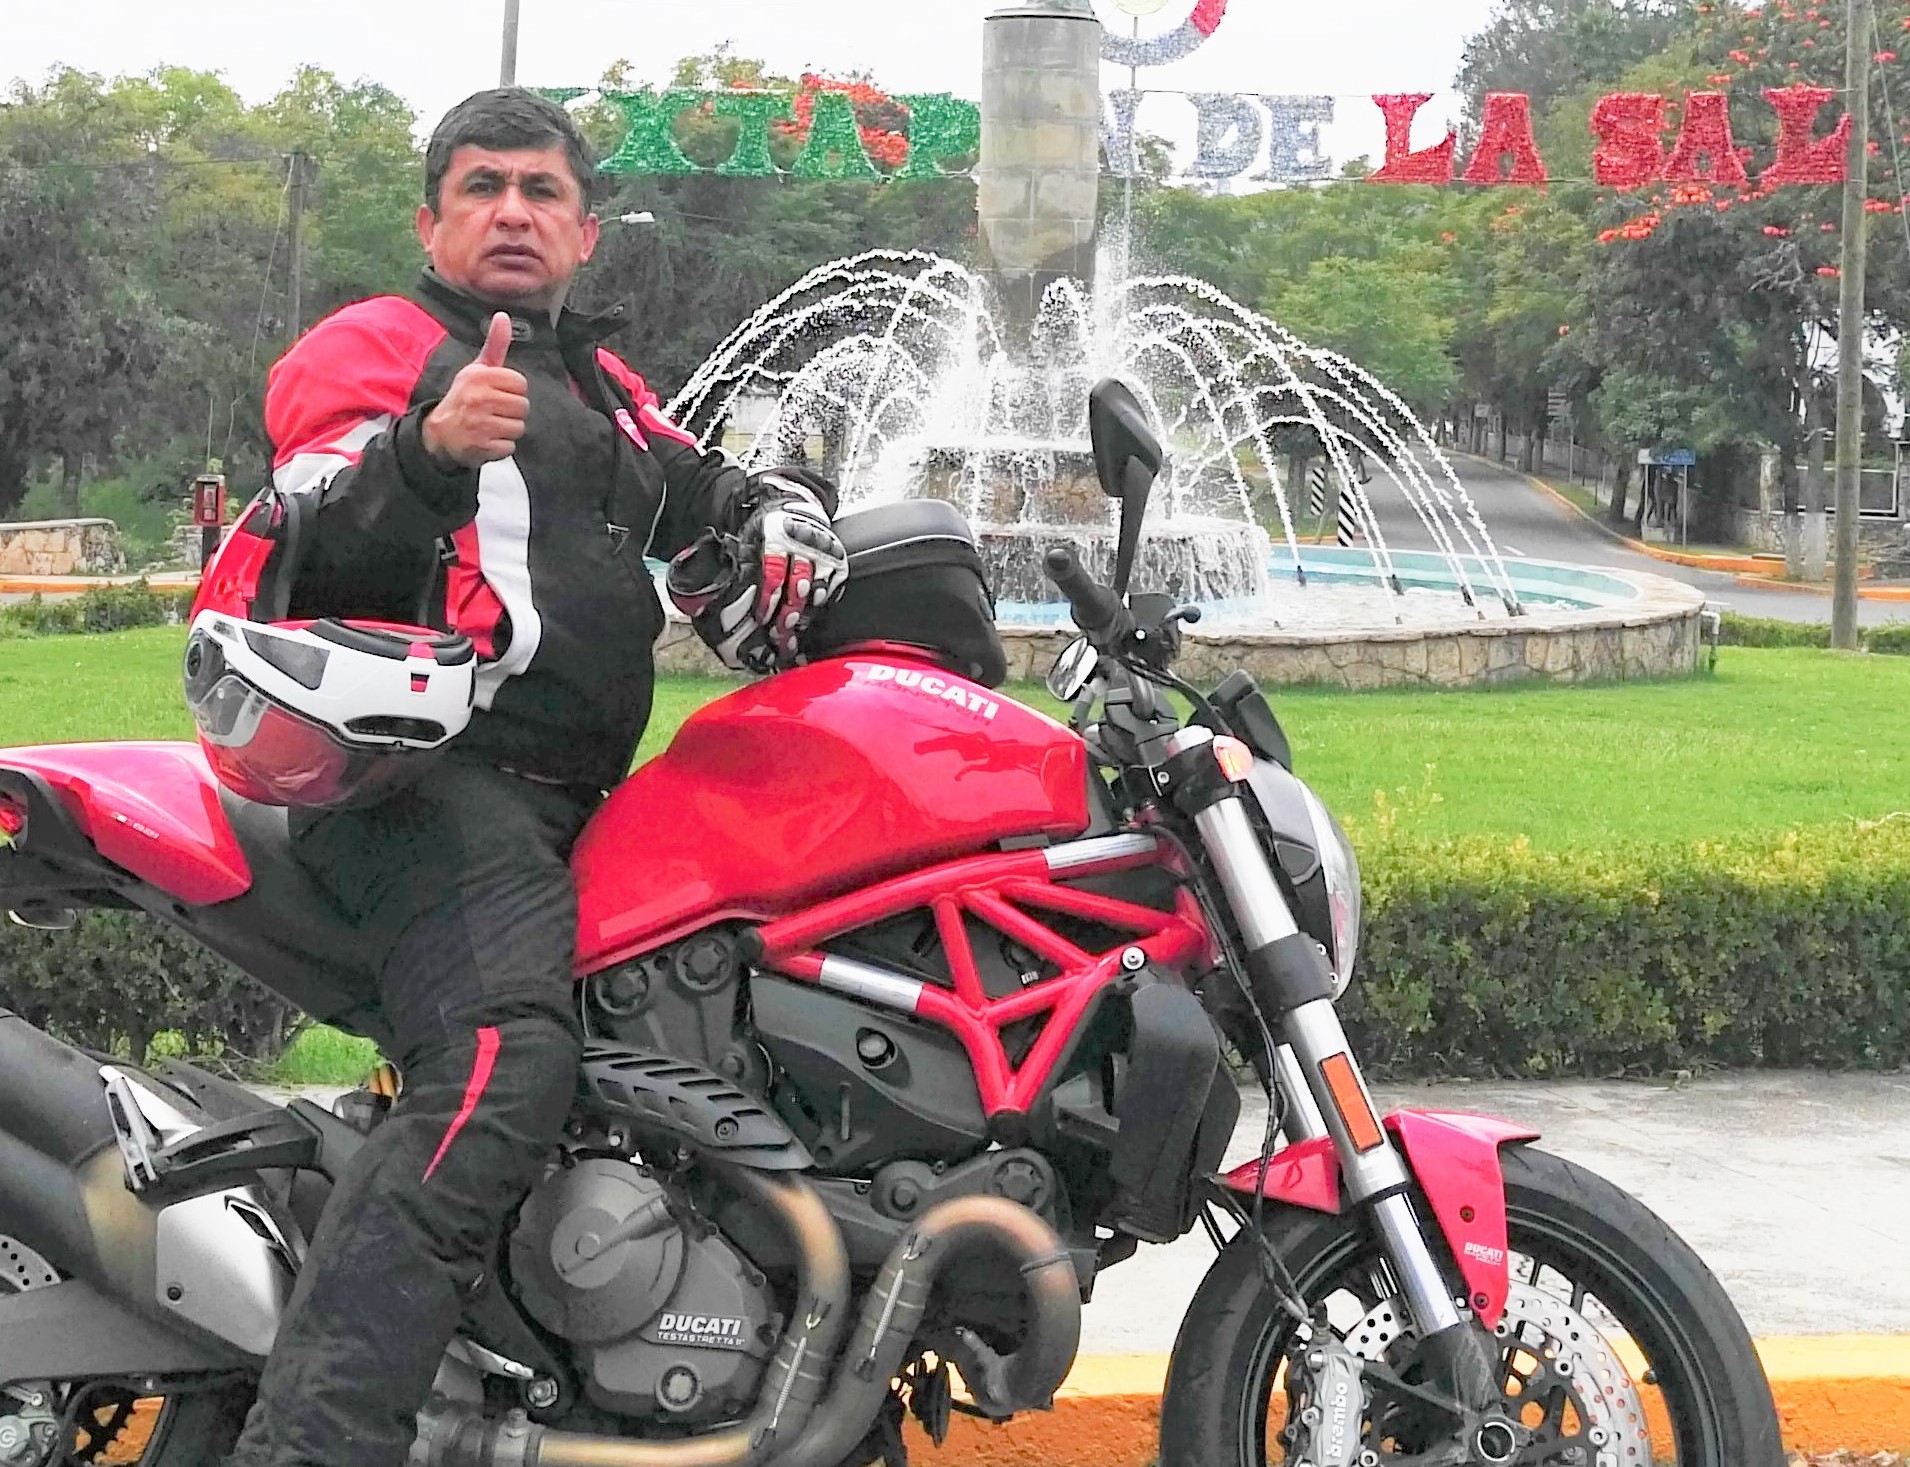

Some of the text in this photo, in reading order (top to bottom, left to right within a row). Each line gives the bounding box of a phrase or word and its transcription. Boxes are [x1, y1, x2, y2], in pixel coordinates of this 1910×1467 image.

[1185, 92, 1335, 181] DE
[1366, 92, 1548, 184] LA
[1592, 88, 1852, 187] SAL
[867, 663, 1000, 720] DUCATI
[1464, 1241, 1504, 1260] DUCATI
[657, 1331, 734, 1345] TESTASTRETTA
[658, 1313, 742, 1335] DUCATI
[1325, 1382, 1348, 1458] brembo
